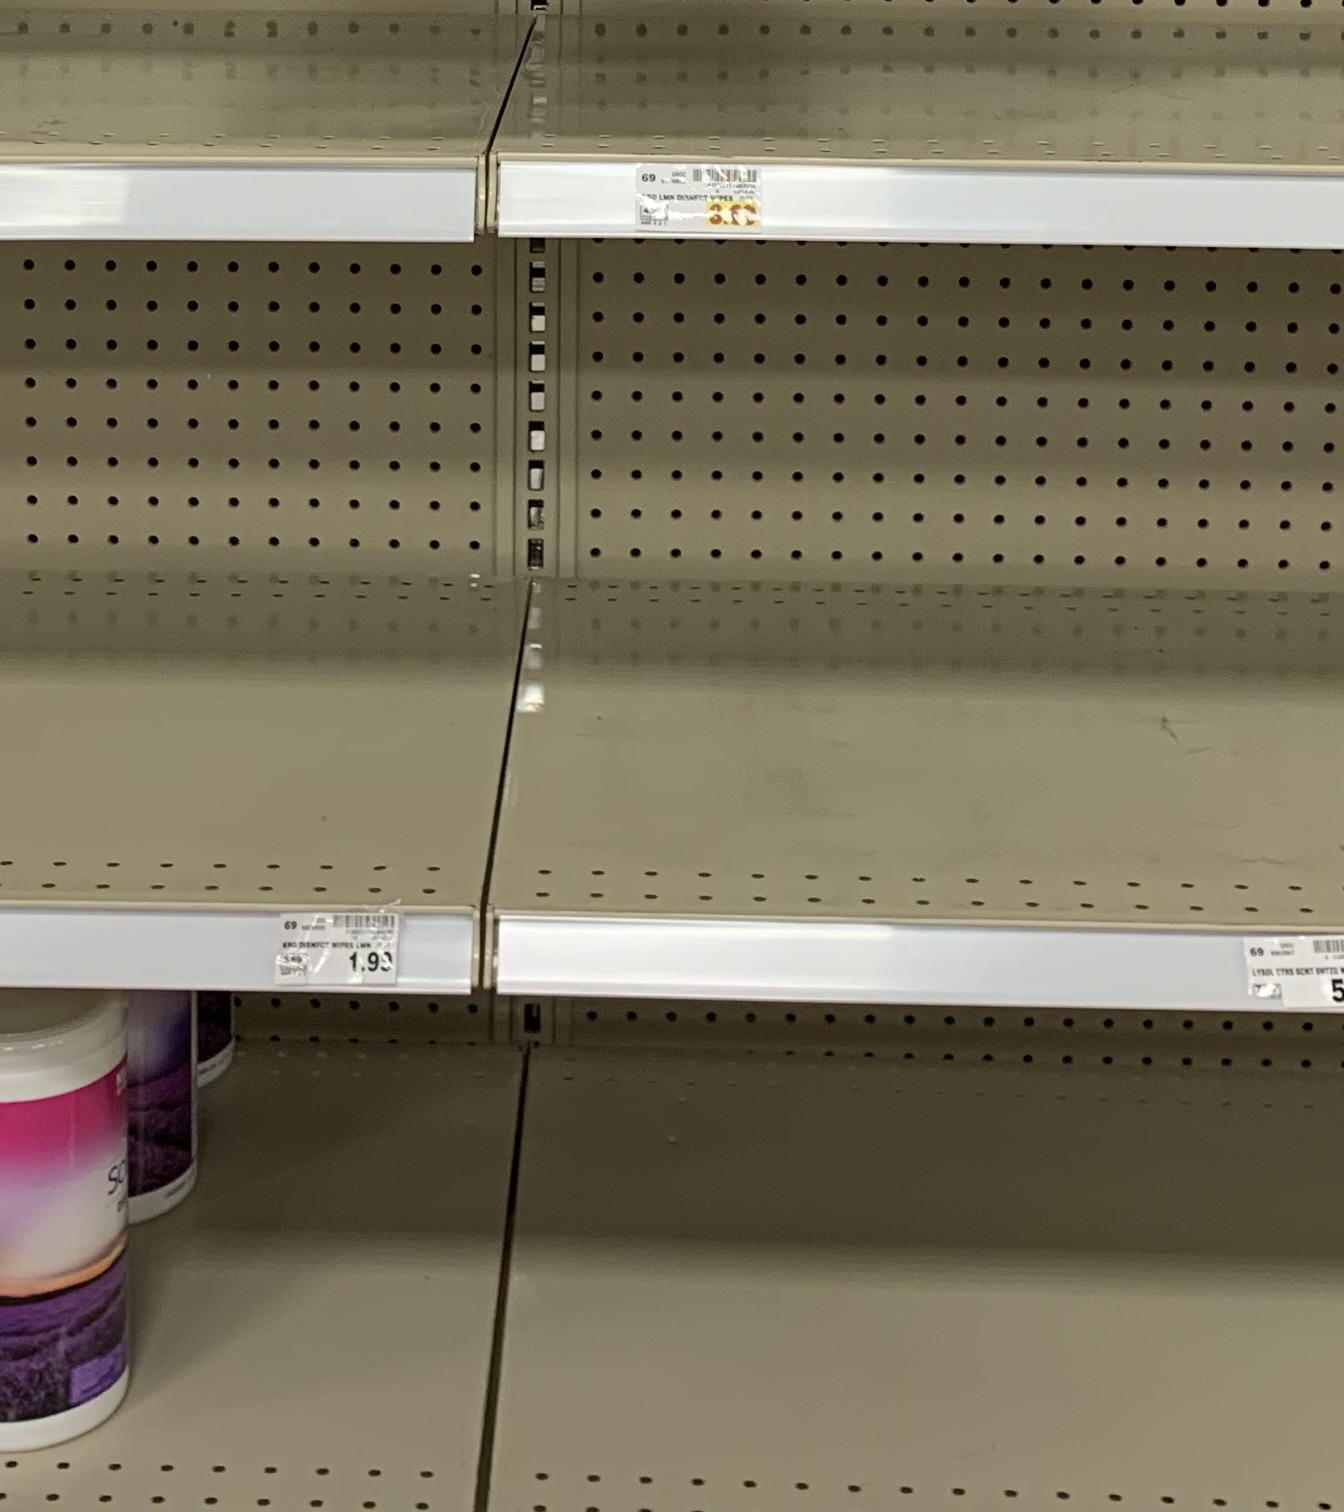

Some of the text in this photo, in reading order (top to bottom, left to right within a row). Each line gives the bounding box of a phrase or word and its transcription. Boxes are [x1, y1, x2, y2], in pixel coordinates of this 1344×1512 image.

[641, 173, 656, 182] 69
[283, 920, 298, 930] 69
[1249, 947, 1265, 957] 69
